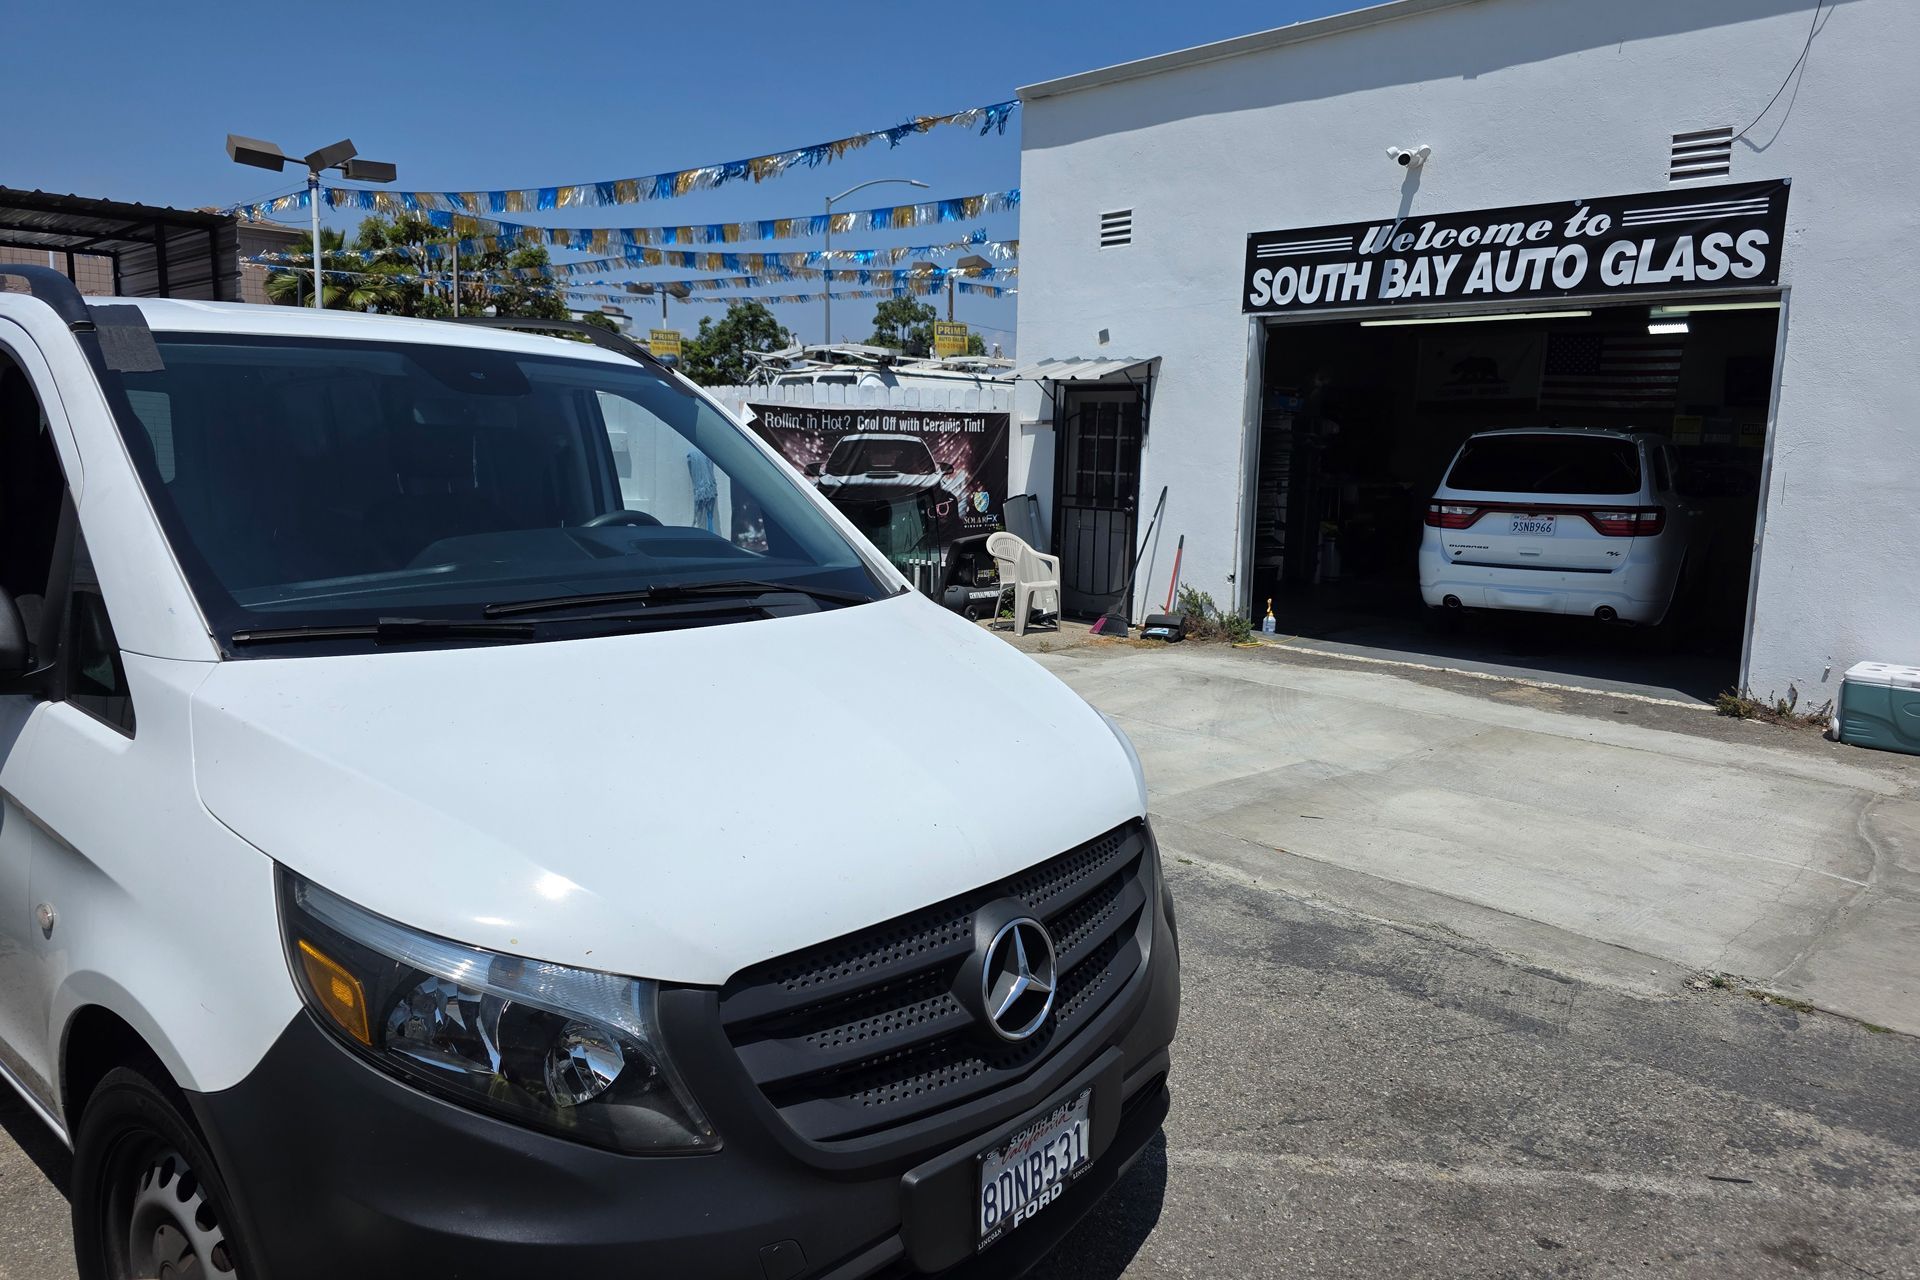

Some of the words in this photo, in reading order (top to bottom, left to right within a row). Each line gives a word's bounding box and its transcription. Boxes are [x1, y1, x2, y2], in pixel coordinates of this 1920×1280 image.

[1359, 218, 1552, 255] Welcome
[1563, 206, 1612, 237] to
[1250, 260, 1373, 307] SOUTH
[1378, 253, 1463, 299] BAY
[1462, 243, 1588, 294] AUTO
[1600, 229, 1770, 287] GLASS
[652, 332, 680, 341] PRIME
[937, 325, 966, 336] PRIME
[765, 411, 803, 429] Rollin'
[806, 413, 818, 429] in
[821, 414, 851, 430] Hot?
[857, 415, 879, 431] Cool
[882, 416, 896, 431] Off
[899, 416, 920, 432] with
[922, 417, 961, 434] Ceramic
[963, 418, 985, 433] Tint!
[1512, 521, 1553, 533] 9SNB966
[1009, 1117, 1049, 1147] SOUTH
[1051, 1101, 1071, 1121] BAY
[983, 1122, 1085, 1229] 8DNB531
[1013, 1181, 1063, 1229] FORD
